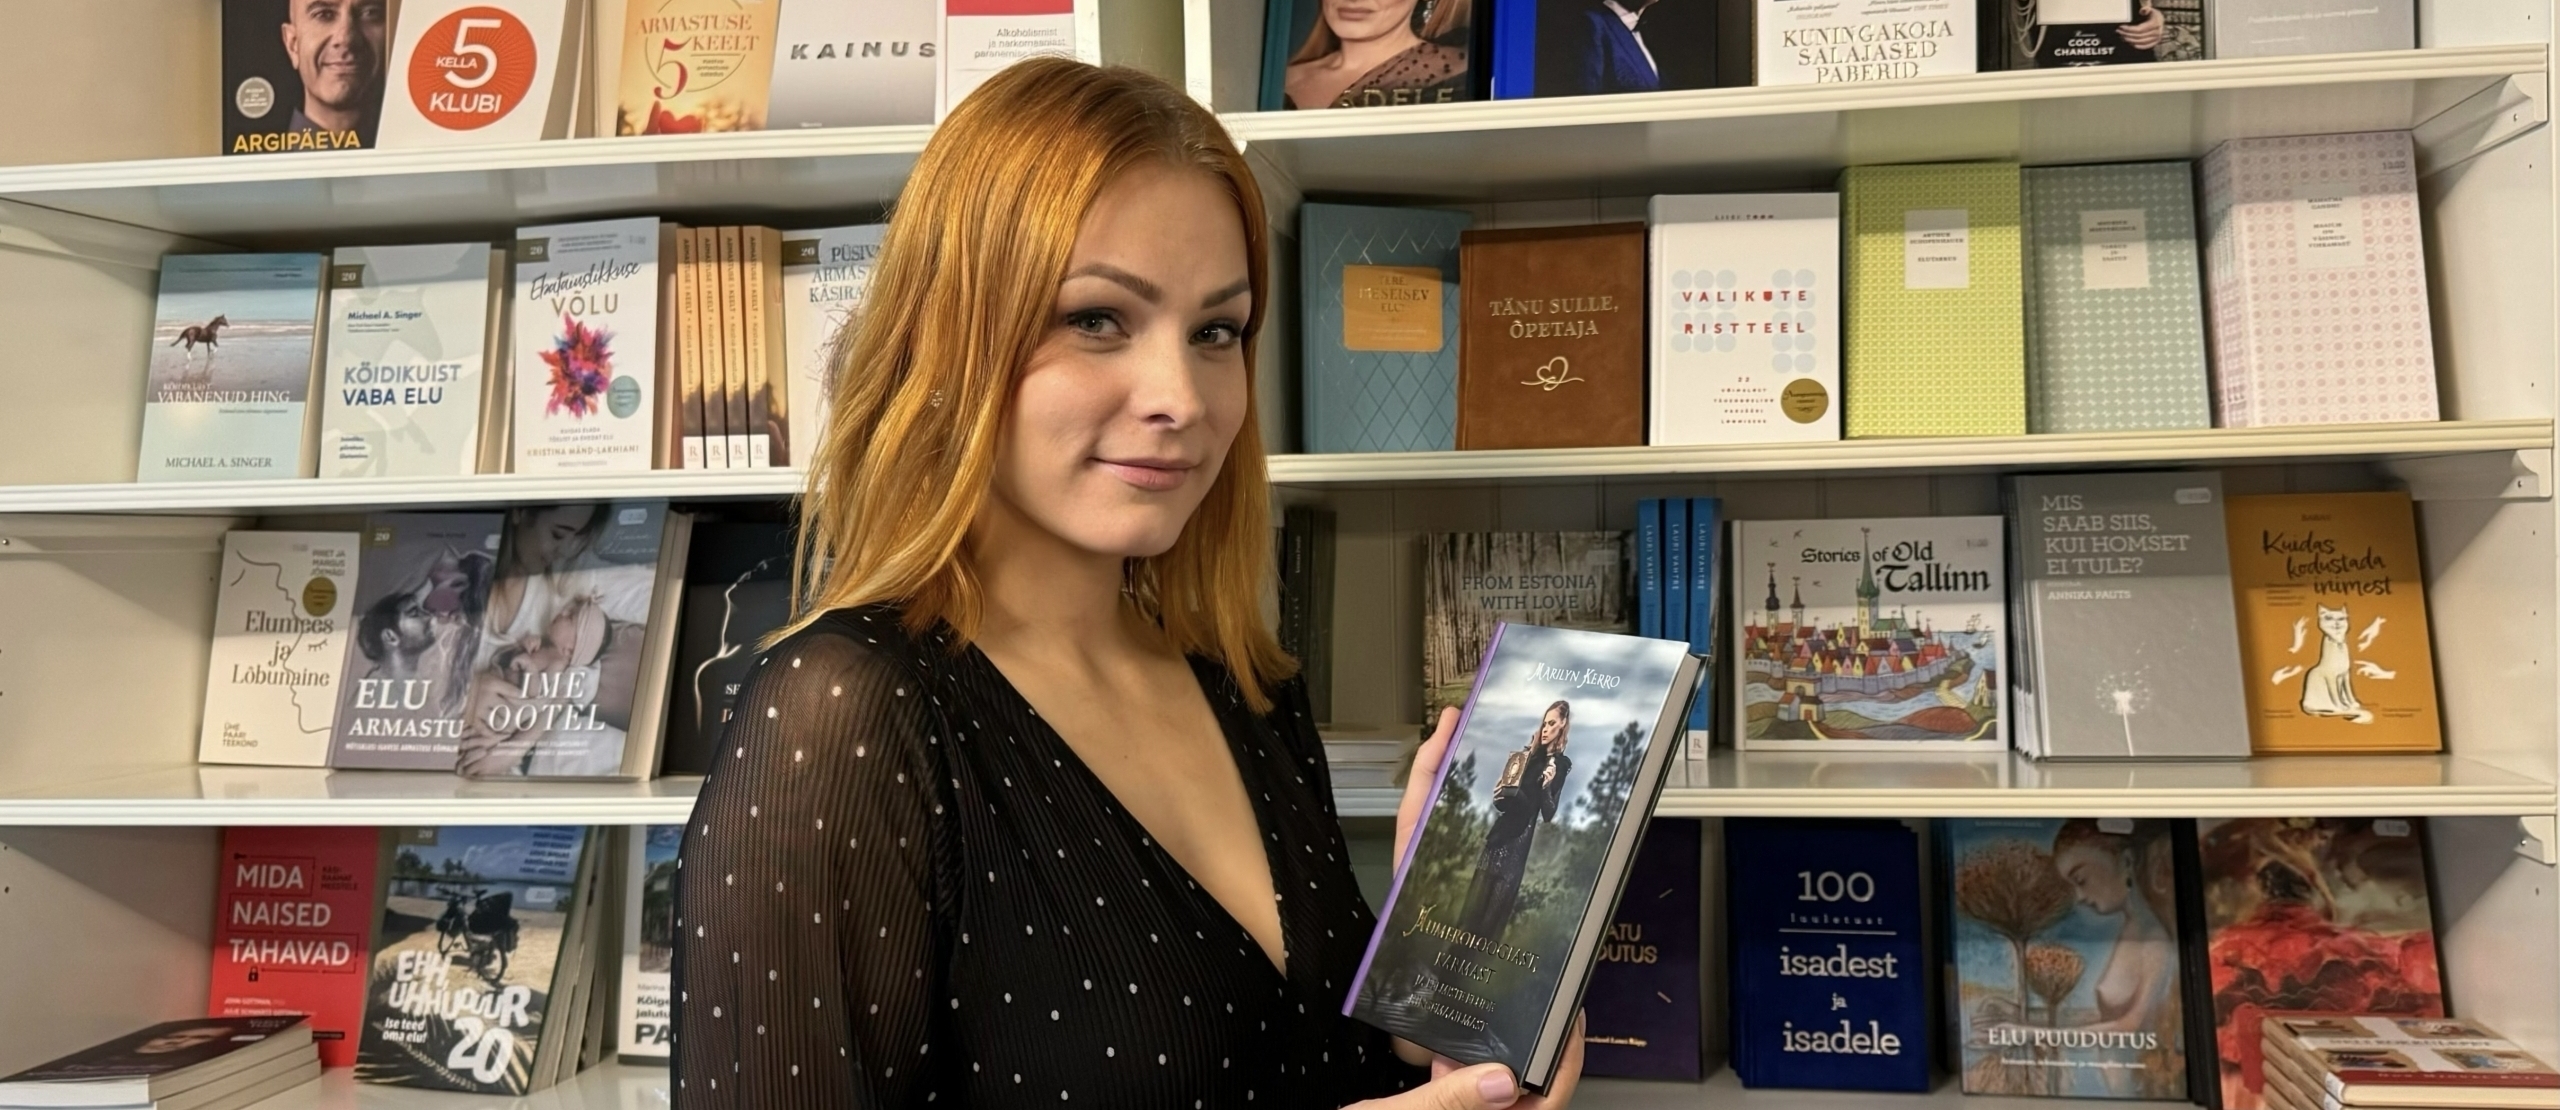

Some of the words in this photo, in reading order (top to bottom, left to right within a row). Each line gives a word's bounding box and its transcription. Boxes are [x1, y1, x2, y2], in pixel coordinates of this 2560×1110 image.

[640, 14, 752, 34] ARMASTUSE
[996, 28, 1058, 37] Alkoholismist
[1783, 20, 1953, 47] KUNINGAKOJA
[444, 18, 502, 89] 5
[692, 35, 759, 51] KEELT
[790, 41, 937, 60] KAINUS
[988, 40, 996, 49] ja
[999, 38, 1066, 48] narkomaaniast
[1799, 40, 1937, 66] SALAJASED
[2054, 46, 2115, 56] CHANELIST
[2068, 38, 2100, 47] COCO
[435, 56, 478, 70] KELLA
[653, 37, 692, 100] 5
[1817, 61, 1919, 83] PABERID
[429, 92, 502, 114] KLUBI
[233, 128, 361, 153] ARGIPÄEVA
[530, 246, 543, 256] 20
[831, 244, 881, 262] PÜSIV
[341, 272, 357, 282] 20
[551, 290, 619, 318] VÕLU
[685, 291, 693, 315] KEELT
[706, 290, 714, 314] KEELT
[728, 289, 736, 313] KEELT
[751, 289, 759, 312] KEELT
[1489, 297, 1544, 317] TÄNU
[1549, 296, 1620, 315] SULLE,
[1682, 289, 1807, 302] VALIKUTE
[348, 311, 382, 321] Michael
[383, 311, 393, 320] A.
[395, 310, 423, 321] Singer
[1509, 319, 1599, 340] ÕPETAJA
[1684, 322, 1805, 334] RISTTEEL
[157, 390, 247, 404] VABANENUD
[251, 390, 290, 404] HING
[342, 388, 396, 406] VABA
[404, 387, 442, 405] ELU
[690, 446, 698, 457] R
[712, 445, 721, 456] R
[734, 444, 743, 455] R
[756, 443, 764, 454] R
[165, 457, 215, 468] MICHAEL
[217, 457, 228, 468] A.
[230, 457, 272, 468] SINGER
[2041, 495, 2083, 511] MIS
[2043, 515, 2105, 533] SAAB
[2110, 514, 2158, 533] SIIS,
[1698, 523, 1706, 551] LAURI
[2044, 537, 2087, 554] KUI
[2091, 534, 2190, 553] HOMSET
[2263, 529, 2336, 555] Kuidas
[1801, 546, 1861, 563] Stories
[1872, 546, 1889, 562] of
[1892, 540, 1934, 562] Old
[1646, 556, 1654, 591] VAHTRE
[1697, 555, 1706, 590] VAHTRE
[2046, 558, 2067, 575] EI
[2072, 557, 2143, 575] TULE?
[2286, 546, 2386, 581] kodustada
[1462, 576, 1513, 591] FROM
[1519, 574, 1597, 590] ESTONIA
[1876, 562, 1991, 592] Tallinn
[2313, 576, 2392, 597] inimest
[1480, 595, 1527, 610] WITH
[1533, 595, 1579, 609] LOVE
[2047, 590, 2093, 600] ANNIKA
[2095, 590, 2131, 599] PAUTS
[245, 610, 334, 635] Elumees
[268, 640, 291, 667] ja
[232, 664, 330, 687] Lõbumaine
[520, 671, 586, 699] IME
[1527, 662, 1580, 681] MARILYN
[1576, 668, 1620, 689] KERRO
[355, 678, 432, 710] ELU
[348, 718, 465, 738] ARMASTU
[489, 704, 606, 731] OOTEL
[236, 864, 304, 889] MIDA
[1797, 871, 1875, 902] 100
[232, 901, 331, 927] NAISED
[1790, 912, 1883, 925] luuletust
[1402, 904, 1540, 973] NUMEROLOOGIAST,
[229, 939, 350, 966] TAHAVAD
[1779, 944, 1899, 979] isadest
[1434, 951, 1496, 984] KARMAST
[1831, 992, 1847, 1010] ja
[384, 1017, 399, 1028] Ise
[401, 1018, 426, 1031] teed
[634, 1023, 671, 1045] PA
[382, 1030, 405, 1042] oma
[406, 1031, 428, 1044] elu!
[1782, 1020, 1901, 1056] isadele
[1988, 1028, 2027, 1046] ELU
[2034, 1029, 2158, 1050] PUUDUTUS
[447, 1016, 514, 1084] 20
